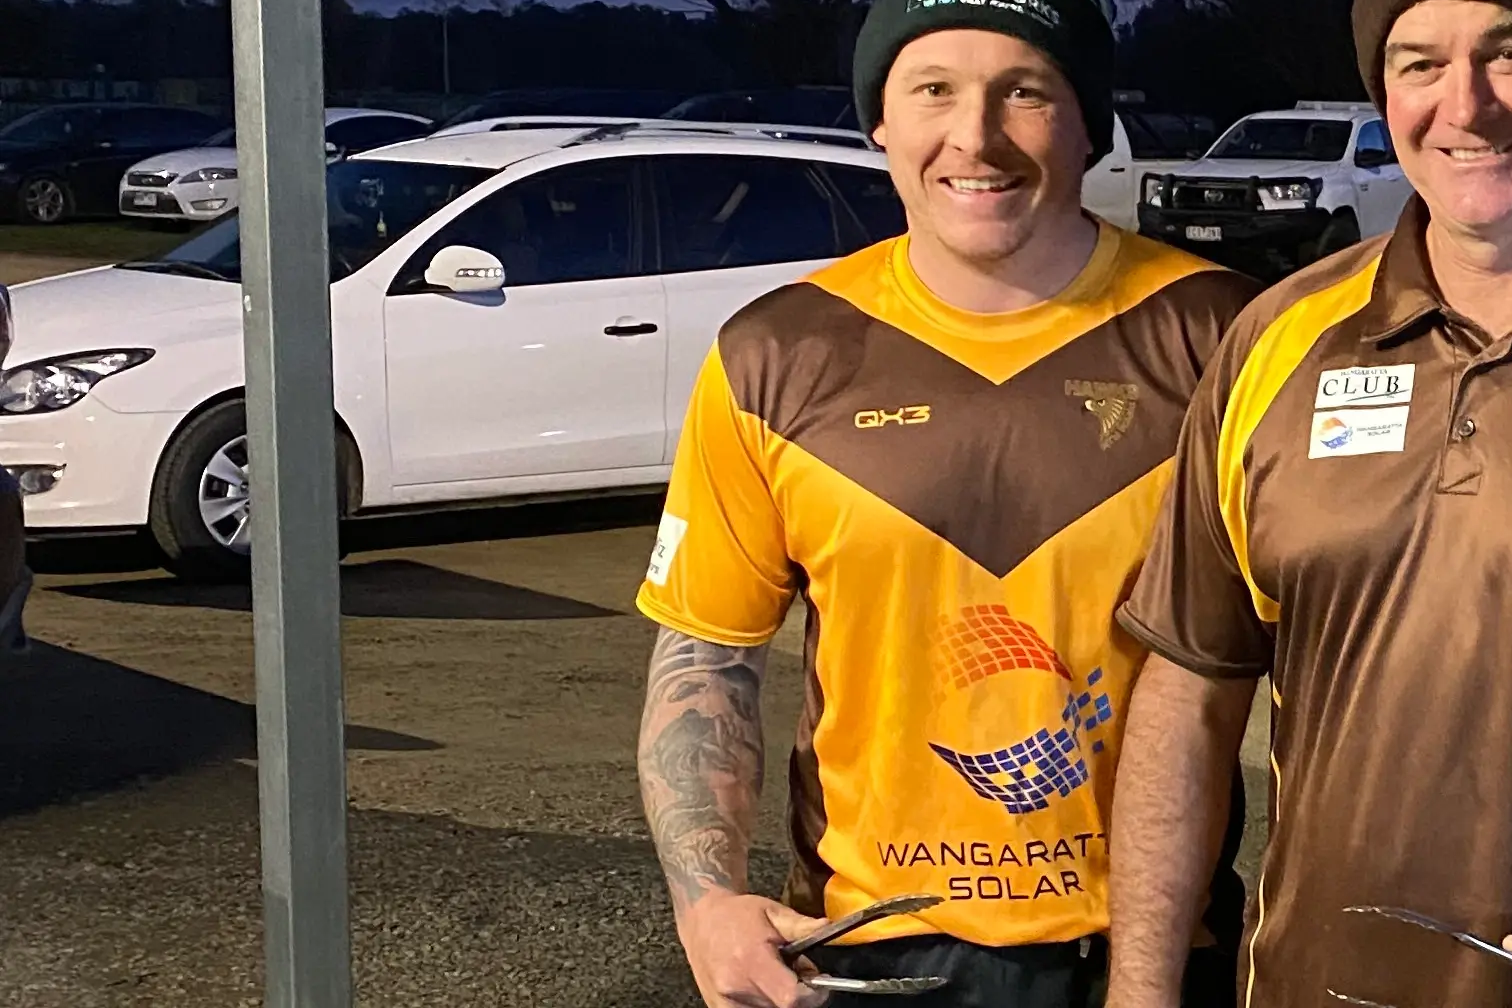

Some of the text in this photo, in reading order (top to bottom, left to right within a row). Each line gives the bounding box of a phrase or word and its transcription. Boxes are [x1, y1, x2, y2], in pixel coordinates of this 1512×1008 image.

[1322, 375, 1400, 397] CLUB
[853, 404, 931, 430] QX3
[949, 870, 1085, 901] SOLAR
